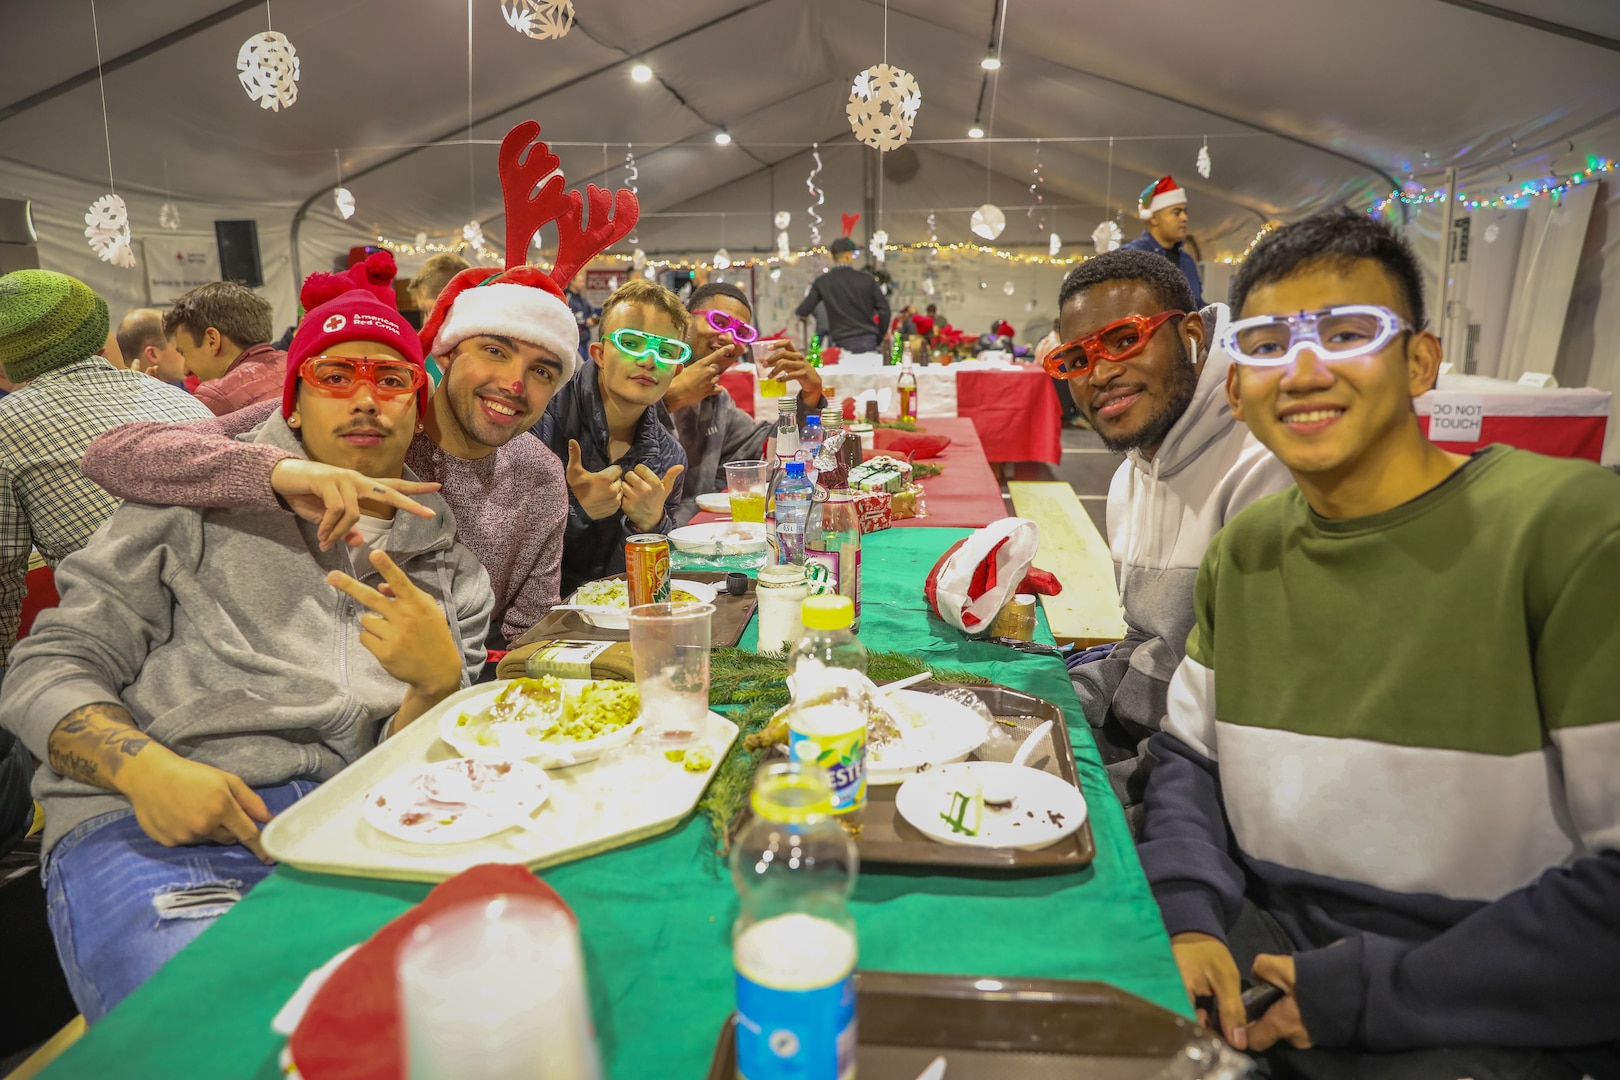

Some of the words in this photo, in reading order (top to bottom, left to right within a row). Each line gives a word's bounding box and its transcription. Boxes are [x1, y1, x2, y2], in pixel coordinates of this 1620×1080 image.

[353, 313, 399, 329] American
[375, 321, 400, 336] Cross
[1433, 404, 1452, 415] DO
[1455, 405, 1482, 416] NOT
[1434, 417, 1479, 430] TOUCH
[527, 660, 587, 673] MILITARY
